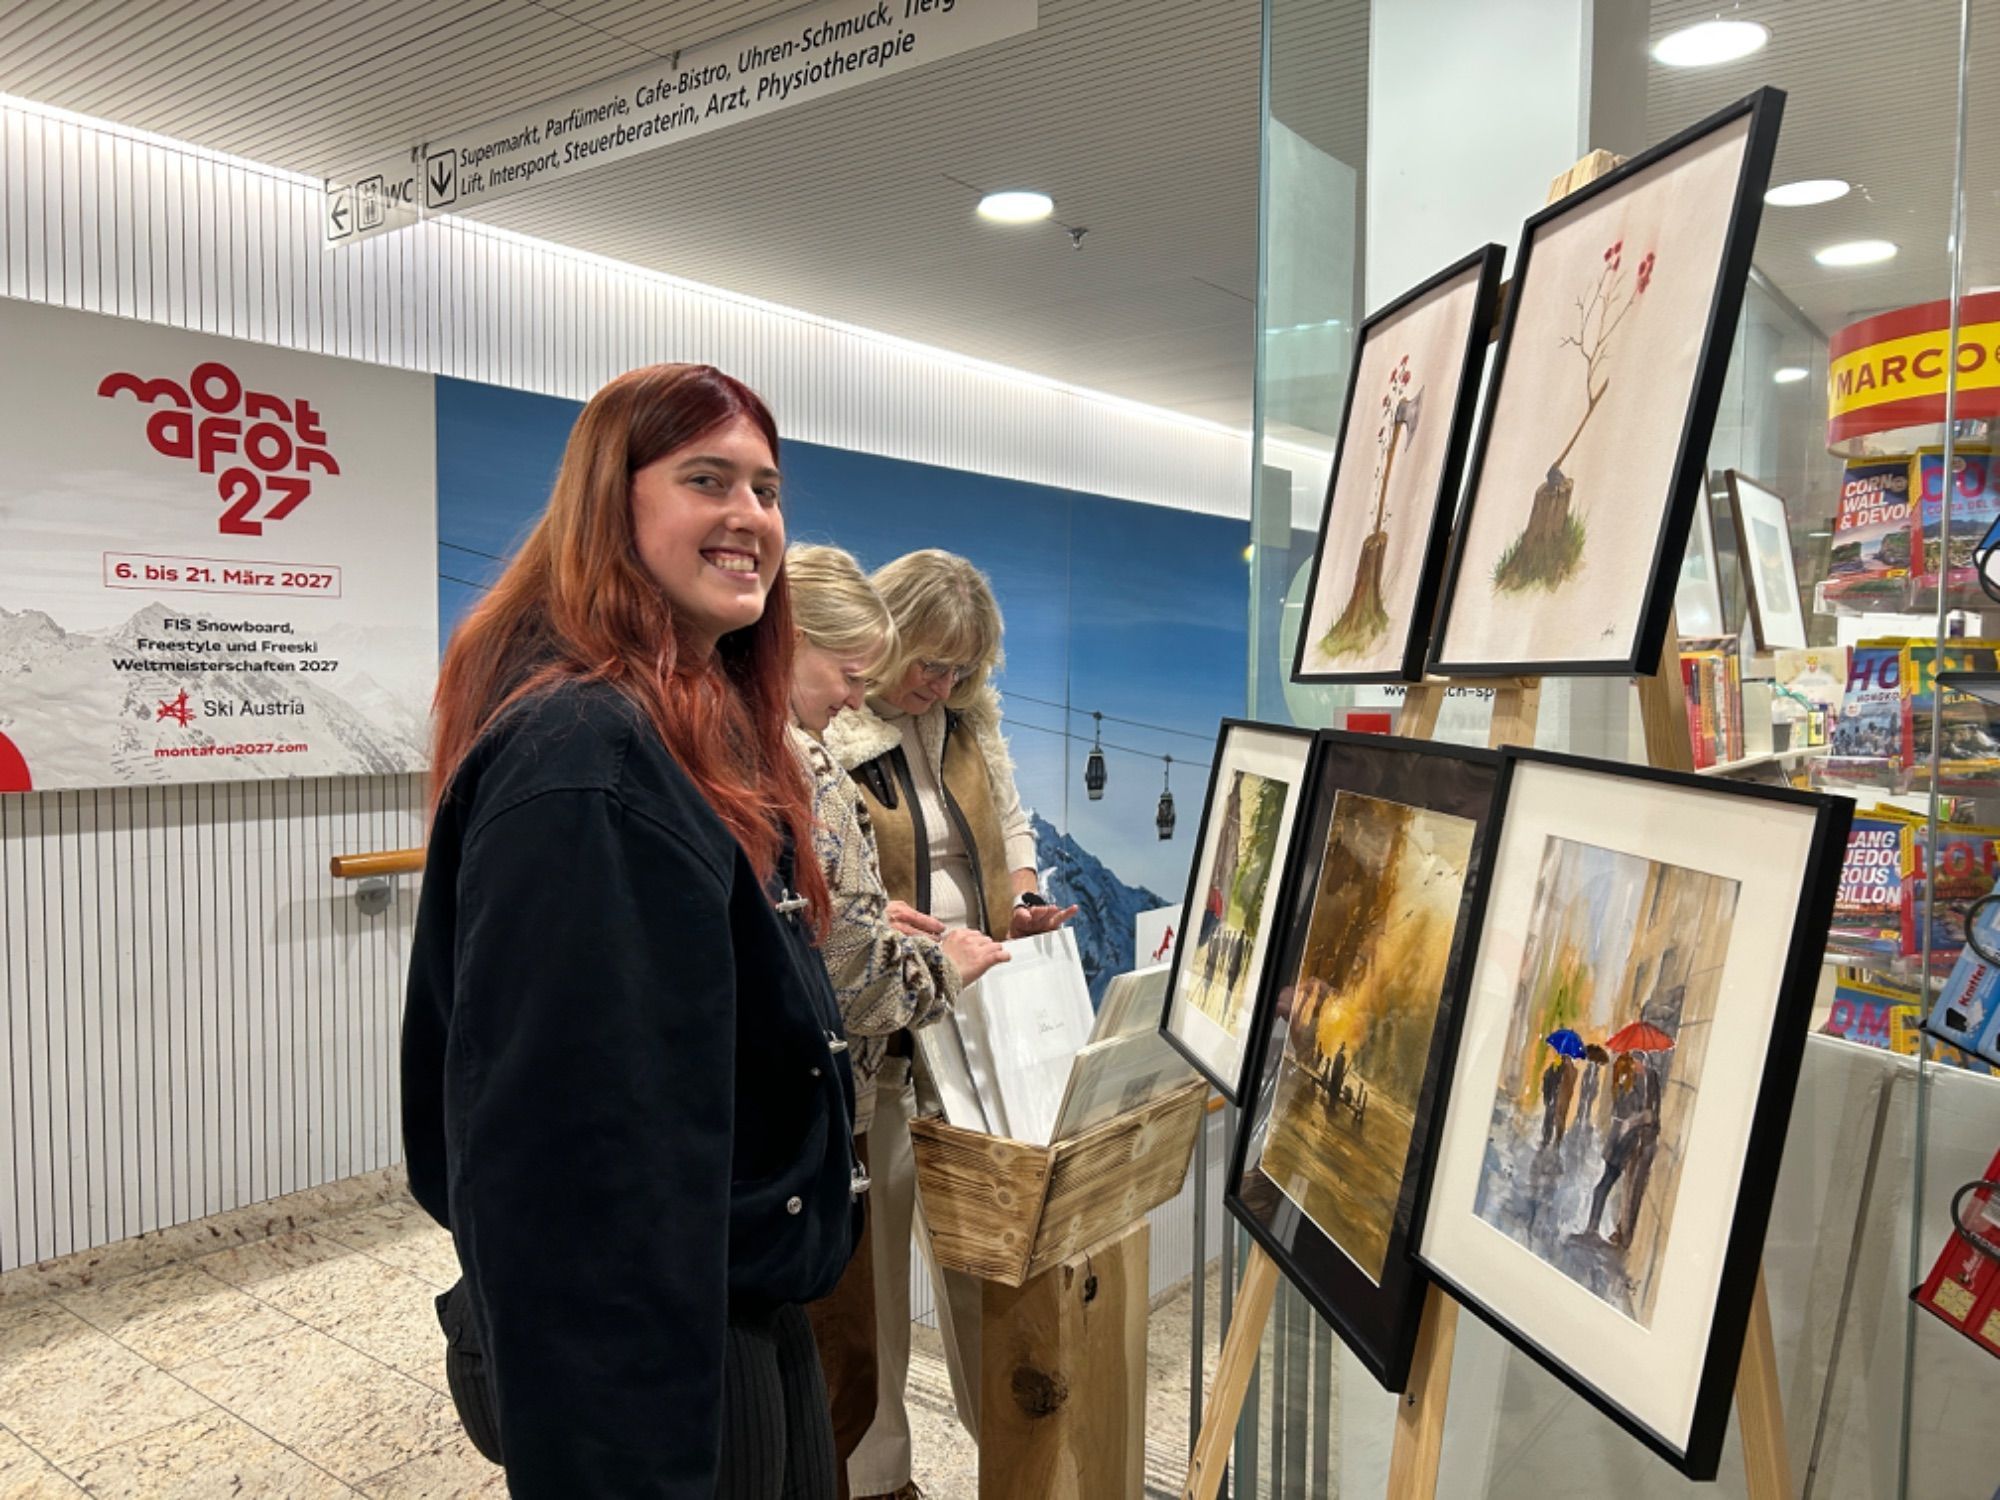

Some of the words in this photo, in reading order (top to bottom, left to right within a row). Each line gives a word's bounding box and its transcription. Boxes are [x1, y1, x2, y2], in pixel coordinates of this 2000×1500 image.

[460, 128, 541, 168] Supermarkt,
[545, 95, 630, 140] Parfümerie,
[636, 62, 731, 109] Cafe-Bistro,
[738, 1, 893, 73] Uhren-Schmuck,
[461, 173, 485, 196] Lift,
[490, 150, 561, 187] Intersport,
[564, 105, 699, 164] Steuerberaterin,
[705, 86, 750, 118] Arzt,
[757, 29, 915, 101] Physiotherapie
[385, 177, 414, 209] WC
[1836, 342, 1987, 400] MARCO
[1845, 474, 1893, 497] CORN
[217, 467, 311, 536] 27
[1843, 491, 1889, 513] WALL
[1840, 514, 1852, 531] &
[114, 563, 138, 579] 6.
[145, 565, 179, 582] bis
[186, 567, 215, 583] 21.
[223, 568, 275, 587] März
[281, 572, 333, 589] 2027
[163, 618, 191, 631] FIS
[196, 618, 294, 635] Snowboard,
[136, 638, 221, 655] Freestyle
[226, 641, 257, 652] und
[261, 641, 318, 653] Freeski
[112, 658, 295, 673] Weltmeisterschaften
[299, 660, 339, 673] 2027
[203, 700, 234, 717] Ski
[239, 699, 305, 717] Austria
[153, 742, 309, 758] montafon2027.com
